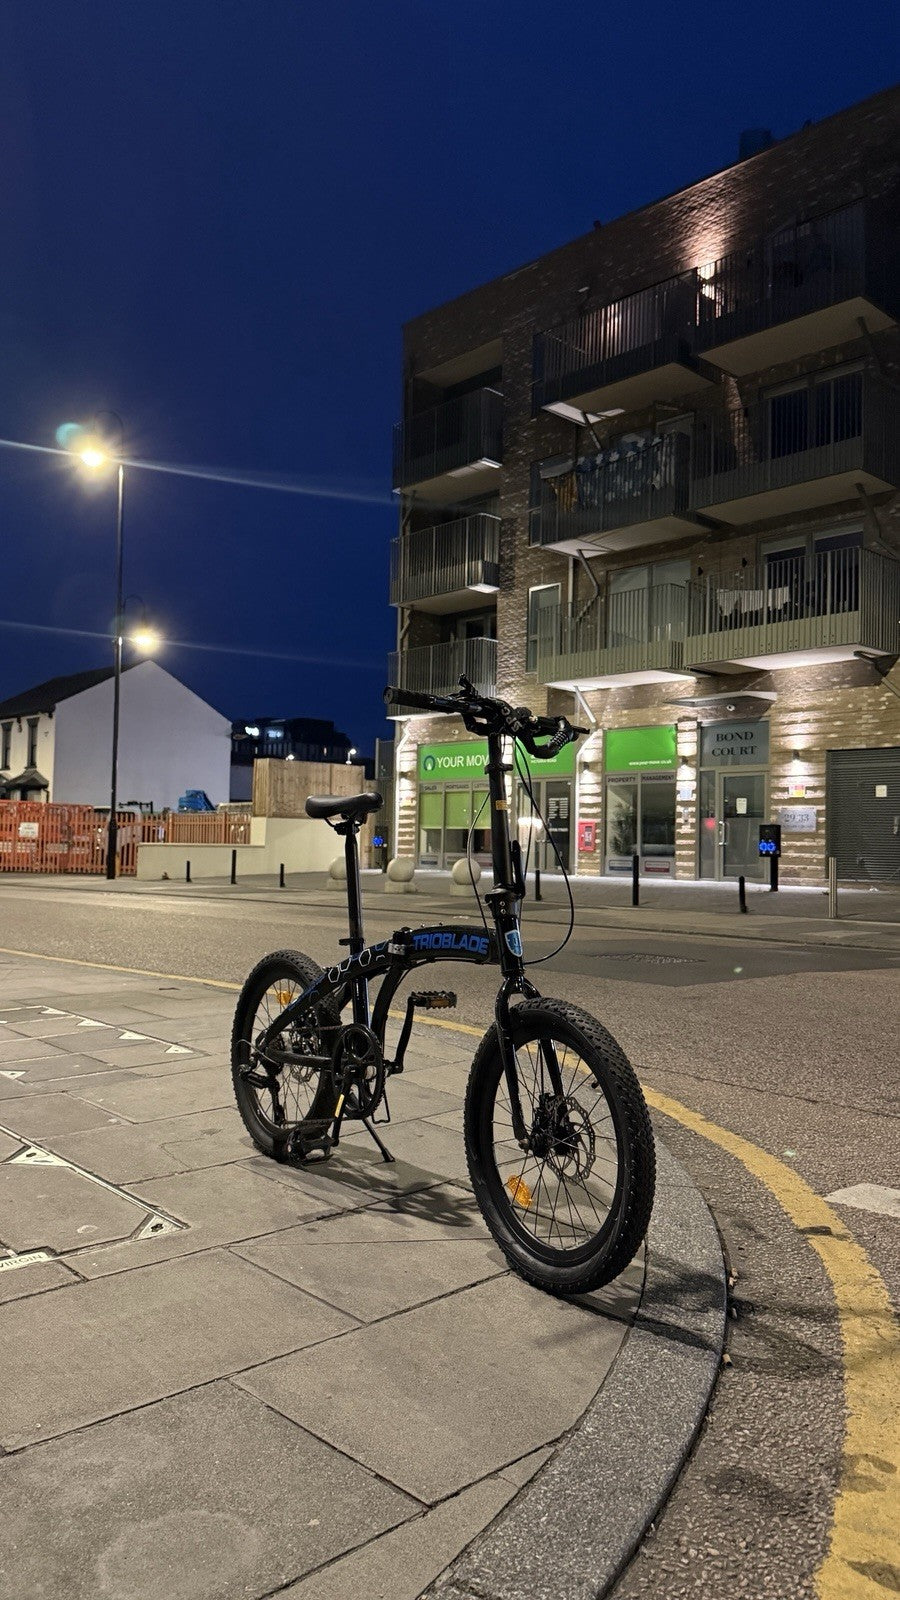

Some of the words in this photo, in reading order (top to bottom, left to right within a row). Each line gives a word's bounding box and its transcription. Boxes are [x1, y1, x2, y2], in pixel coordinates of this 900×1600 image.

[716, 731, 754, 742] BOND
[711, 745, 757, 757] COURT
[436, 755, 465, 768] YOUR
[466, 754, 490, 767] MOV
[412, 932, 489, 955] TRIOBLADE
